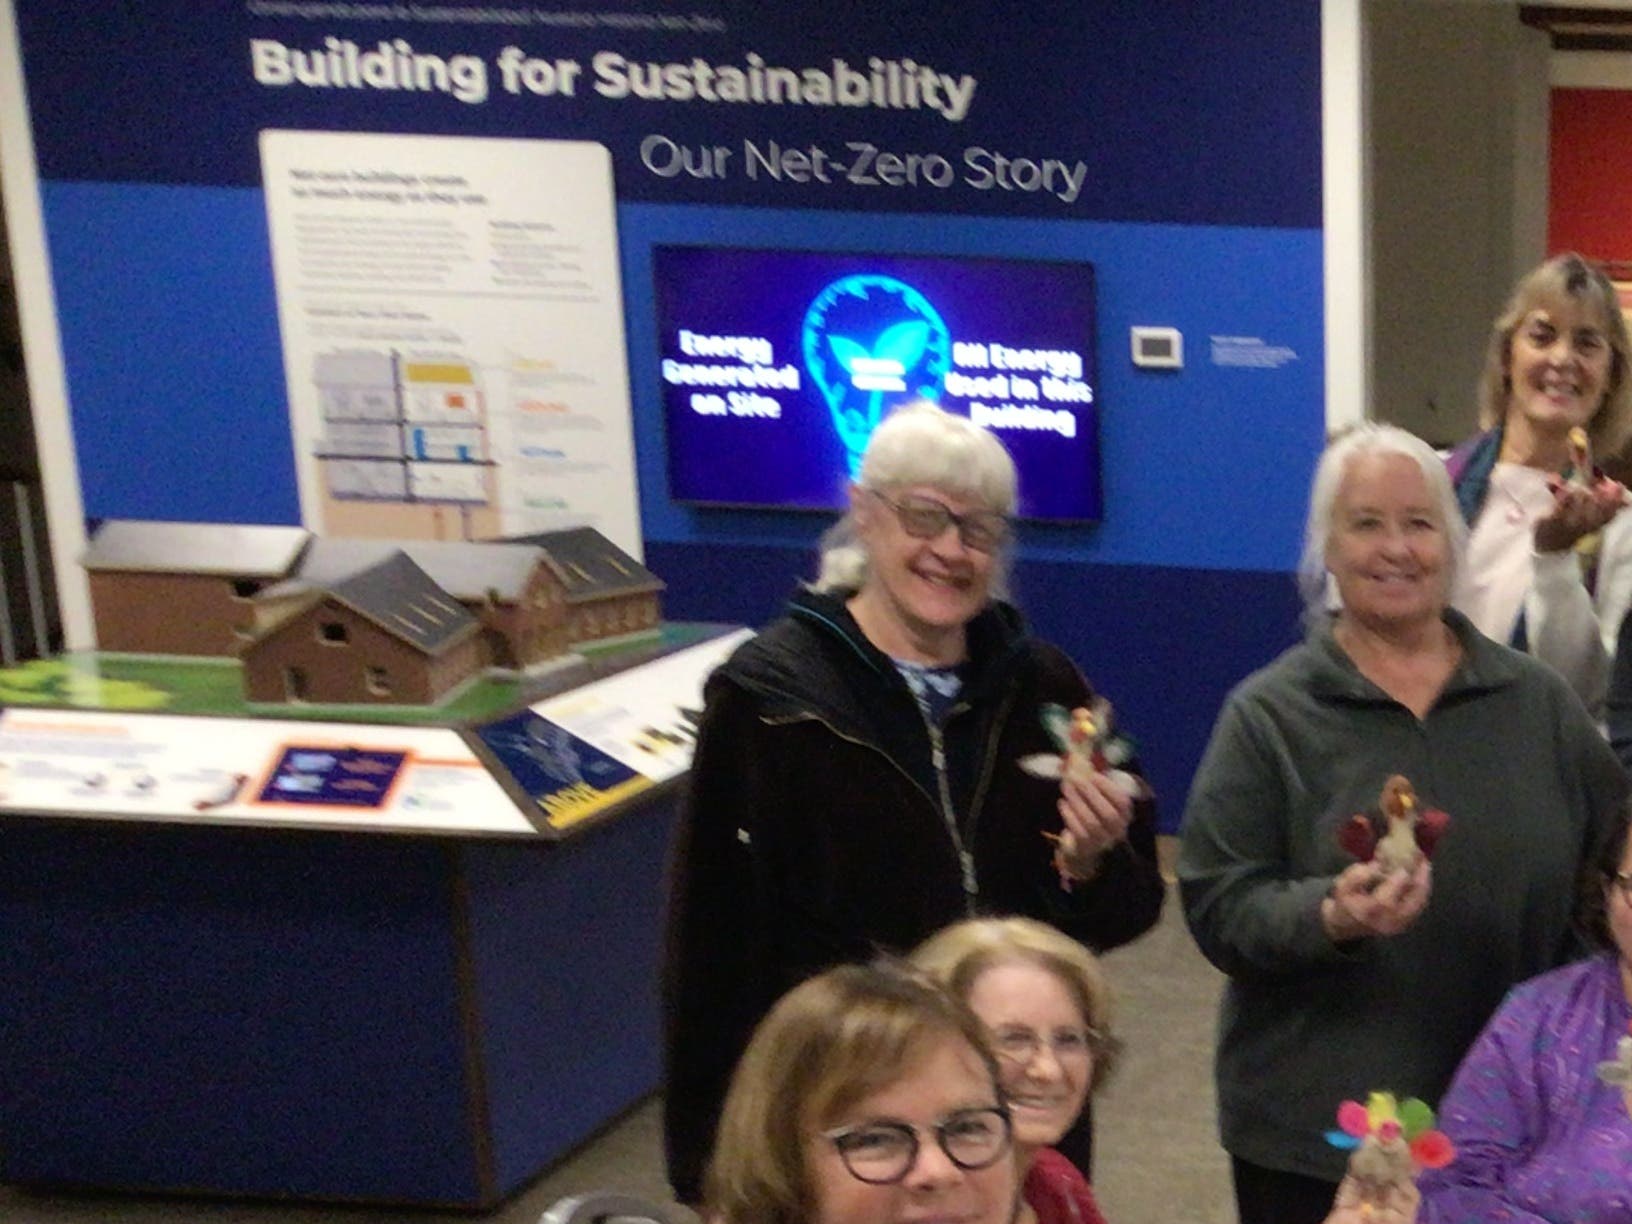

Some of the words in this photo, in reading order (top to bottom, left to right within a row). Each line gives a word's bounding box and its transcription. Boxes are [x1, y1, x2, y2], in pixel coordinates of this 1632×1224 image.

[250, 36, 488, 103] Building
[497, 45, 582, 97] for
[592, 51, 978, 121] Sustainability
[640, 134, 733, 178] Our
[744, 139, 954, 188] Net-Zero
[964, 146, 1087, 202] Story
[679, 329, 773, 365] Energy
[989, 343, 1083, 379] Energy
[662, 359, 800, 390] Generated
[944, 371, 1010, 398] Used
[1010, 374, 1039, 401] in
[727, 391, 781, 418] Site
